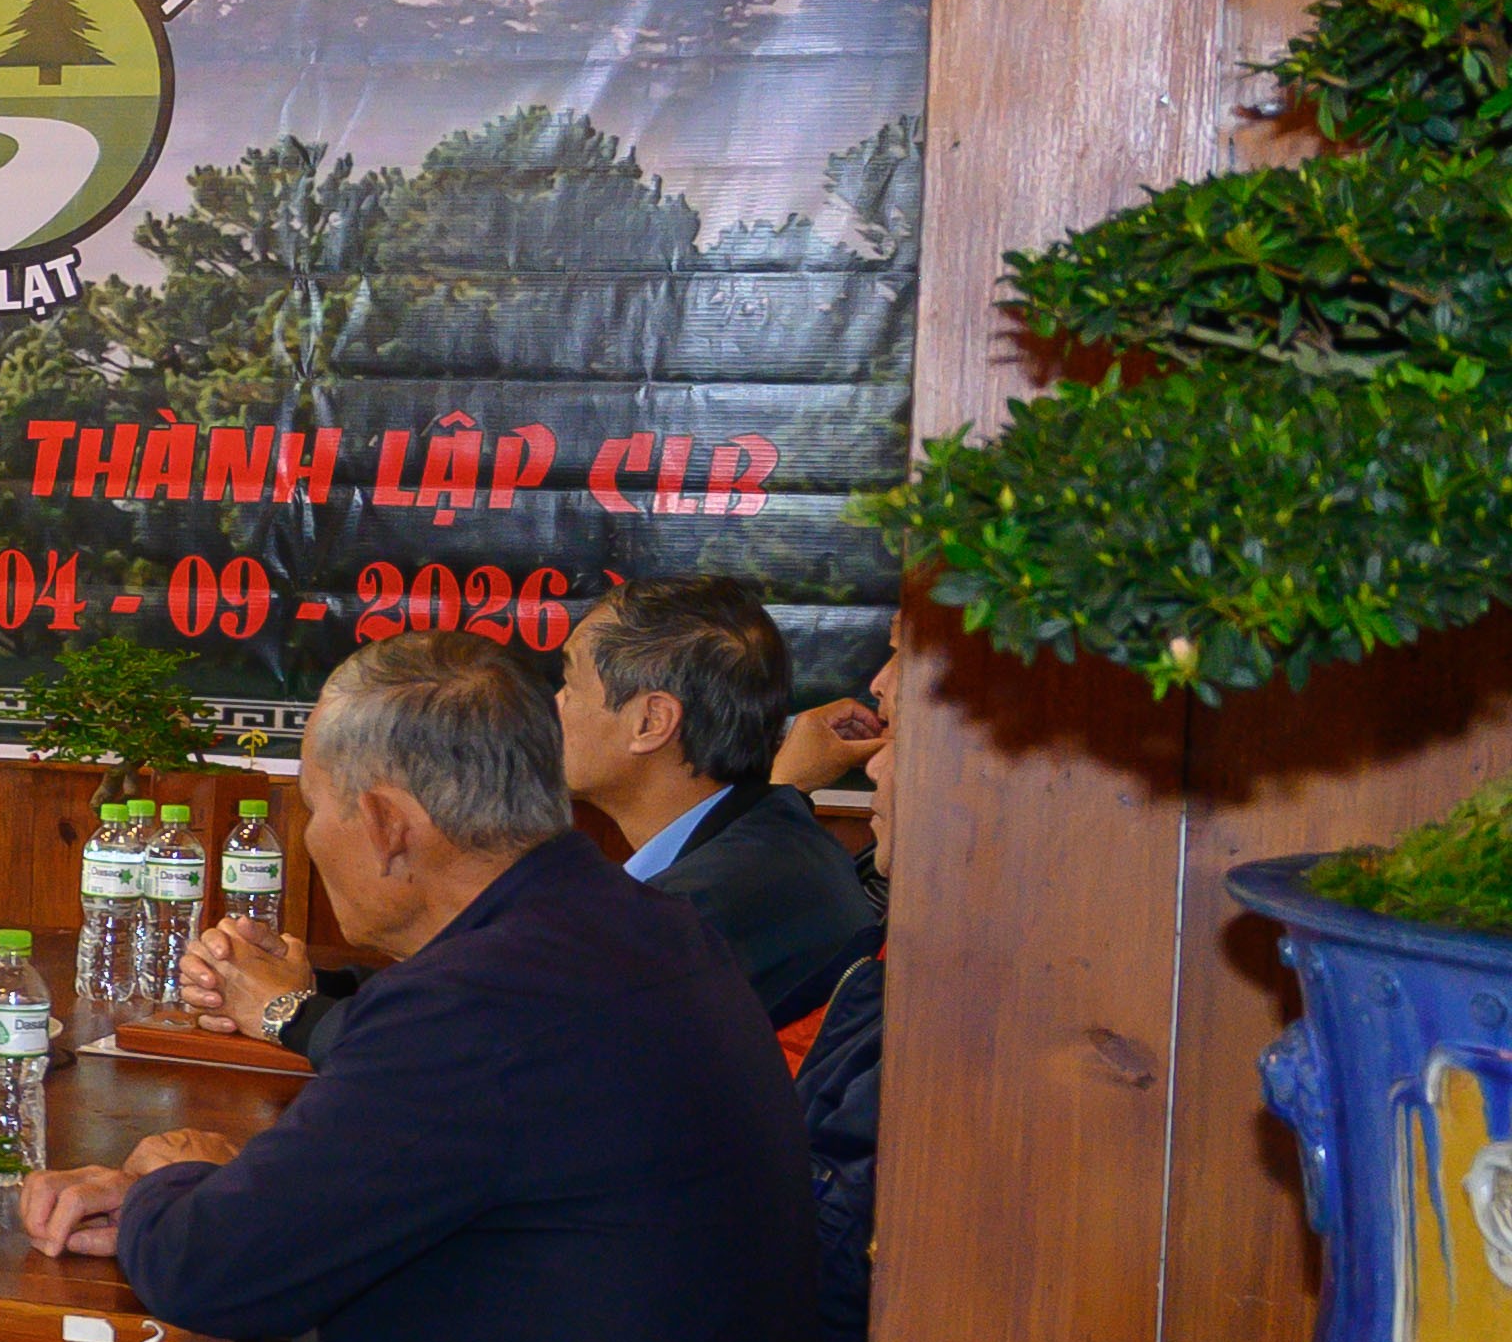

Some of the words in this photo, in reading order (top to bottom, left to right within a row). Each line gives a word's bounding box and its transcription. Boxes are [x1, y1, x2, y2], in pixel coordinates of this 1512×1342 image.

[27, 406, 344, 506] THÀNH
[370, 409, 558, 527] LẬP
[586, 431, 782, 518] CLB
[166, 553, 272, 640] 09
[355, 561, 571, 652] 2026
